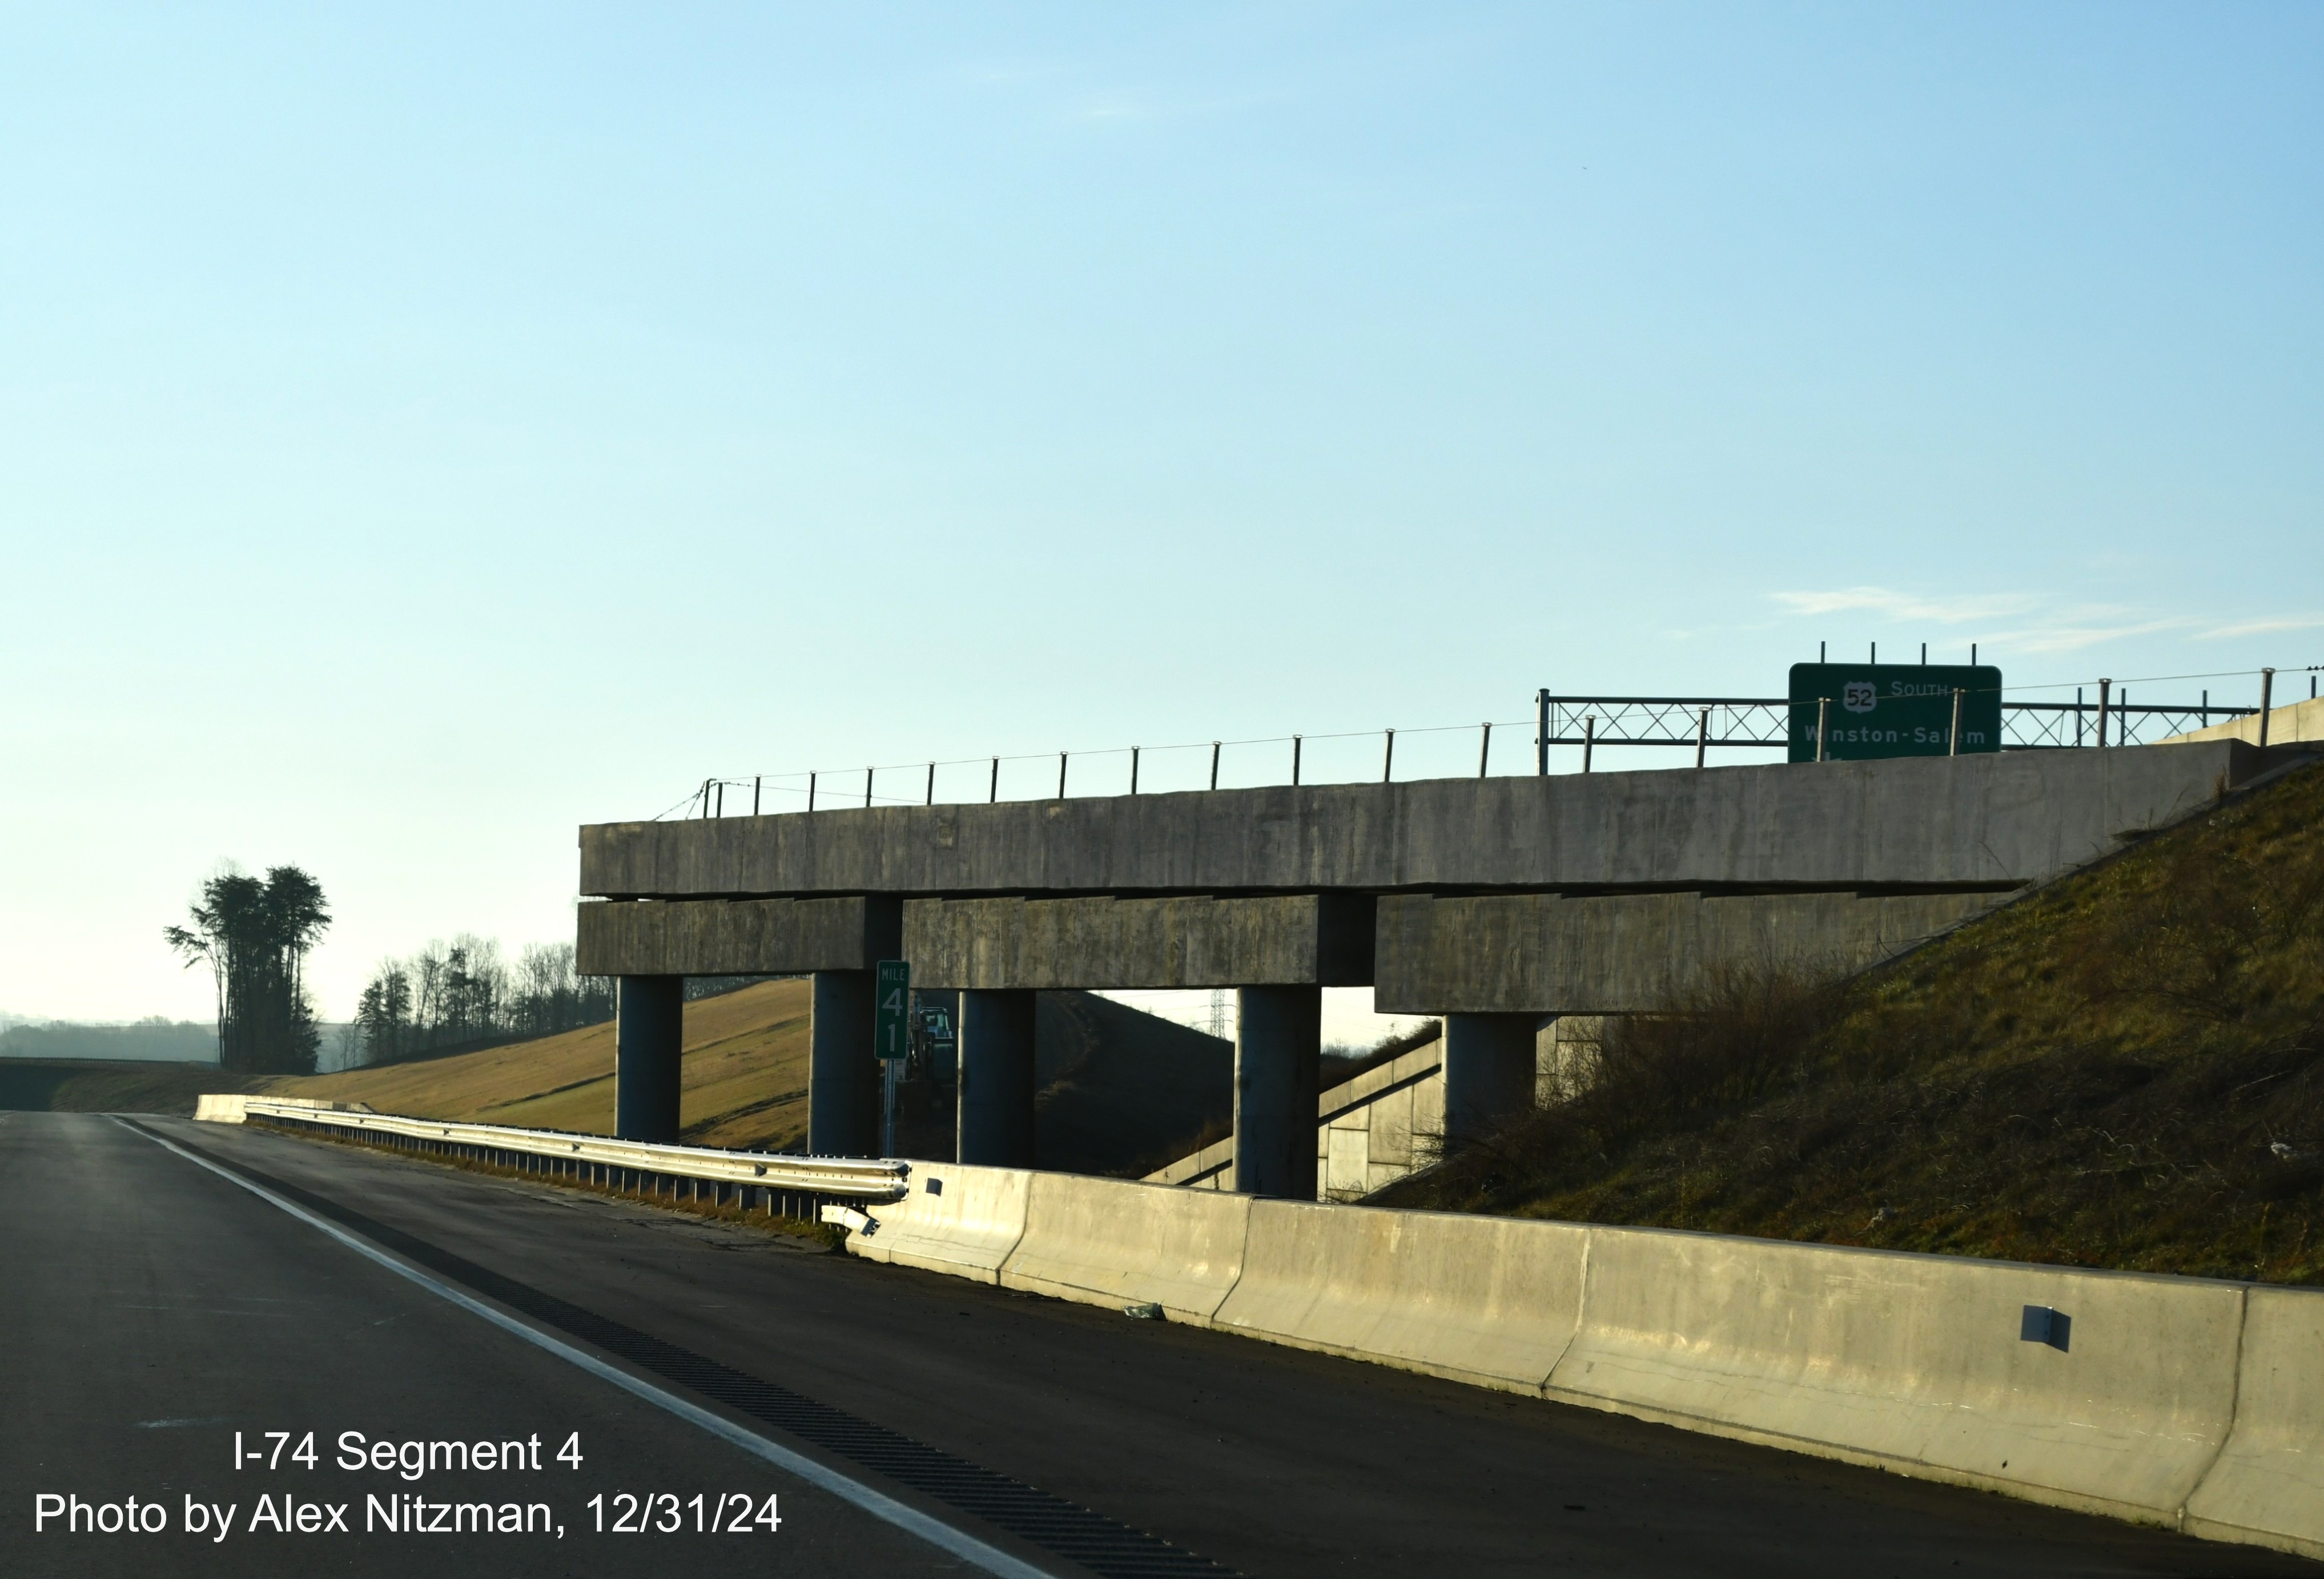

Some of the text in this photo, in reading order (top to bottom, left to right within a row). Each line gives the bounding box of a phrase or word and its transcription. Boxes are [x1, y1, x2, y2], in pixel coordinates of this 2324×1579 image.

[1847, 680, 1948, 707] 52 SOUTH
[1804, 724, 1985, 744] Wnston-Salm
[882, 968, 905, 981] MILE
[882, 988, 903, 1017] 4
[887, 1024, 896, 1052] 1
